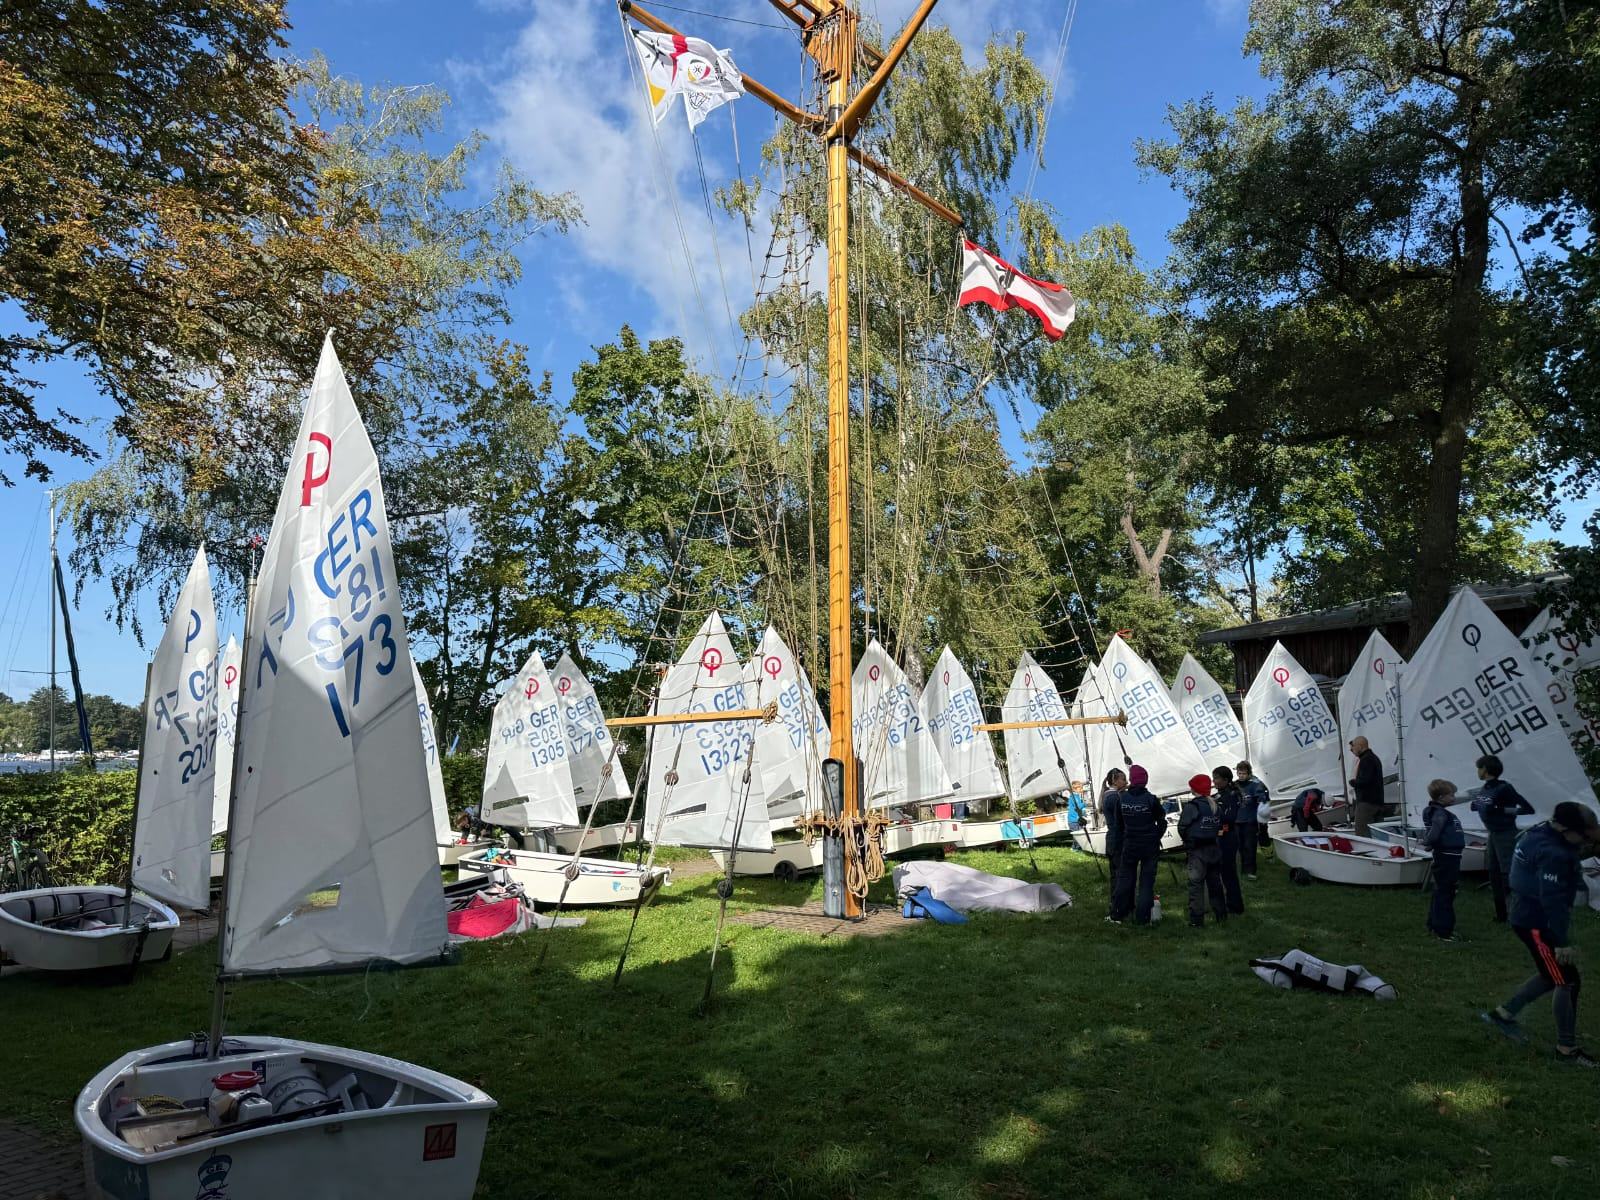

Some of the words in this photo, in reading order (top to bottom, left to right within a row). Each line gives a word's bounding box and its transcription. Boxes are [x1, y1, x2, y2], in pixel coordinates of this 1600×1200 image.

[1475, 656, 1524, 698] GER
[566, 695, 597, 720] GER
[1193, 693, 1226, 719] GER
[1288, 687, 1320, 711] GER
[530, 704, 559, 728] GER
[1134, 710, 1178, 743] 1005
[570, 726, 605, 754] 1776
[888, 716, 923, 747] 1672
[1294, 719, 1336, 748] 12812
[1475, 705, 1548, 756] 10848
[532, 741, 564, 767] 1305
